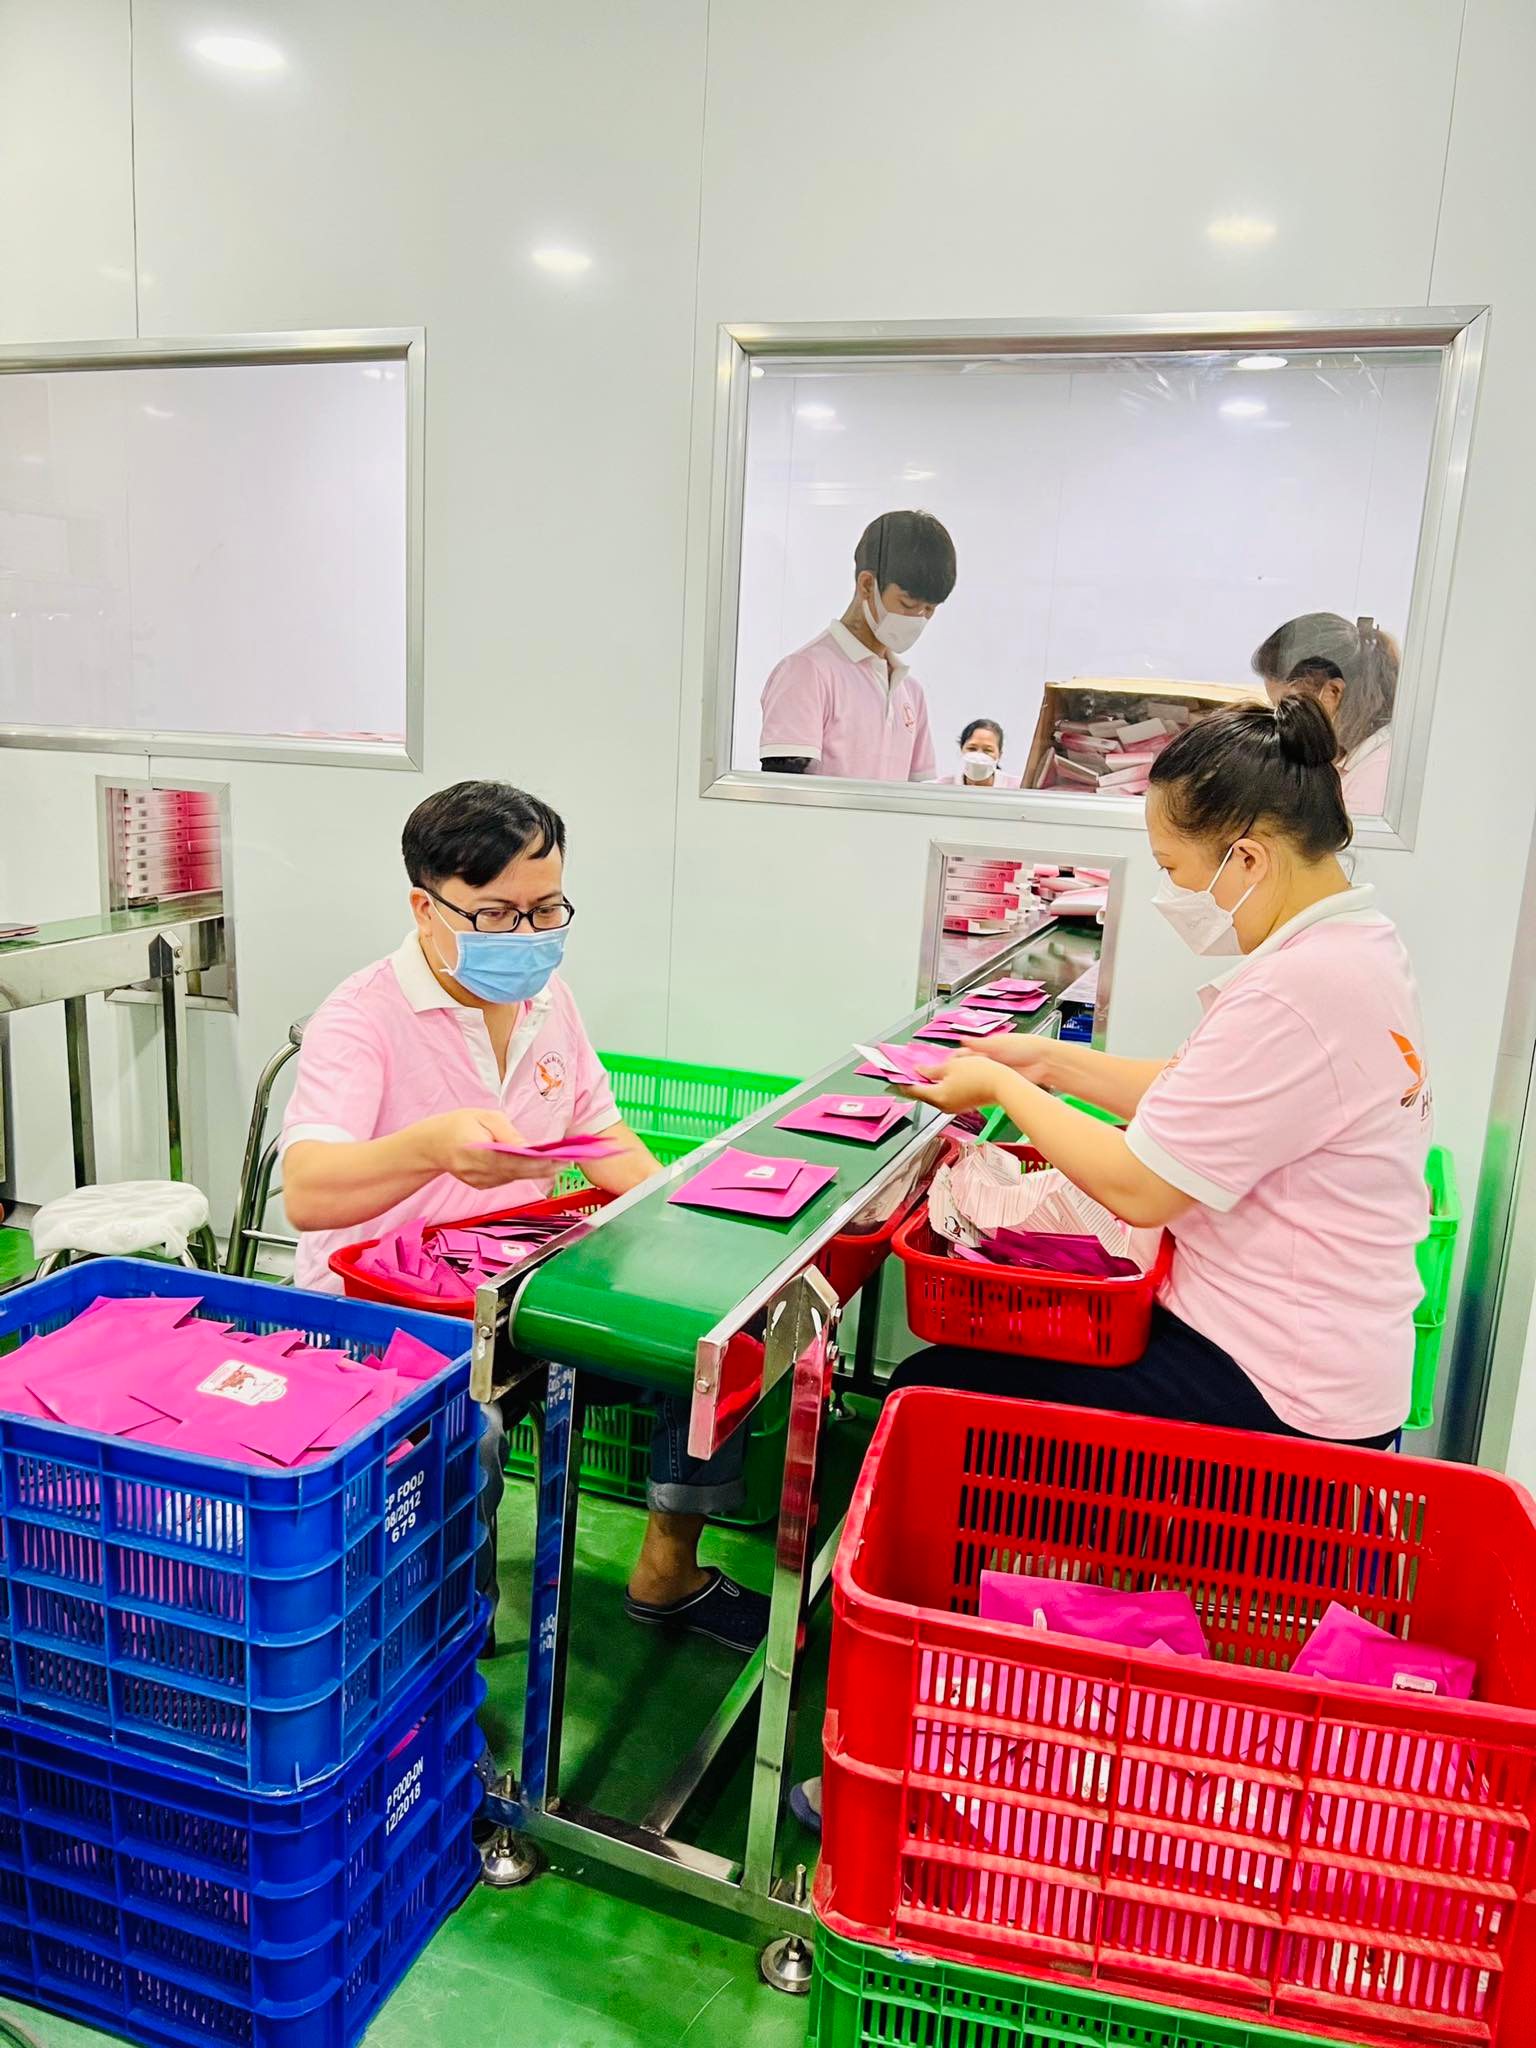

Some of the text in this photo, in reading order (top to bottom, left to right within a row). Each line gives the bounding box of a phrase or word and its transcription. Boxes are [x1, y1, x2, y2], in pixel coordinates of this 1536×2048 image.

[397, 1470, 425, 1502] FOOD
[385, 1491, 421, 1532] 08/2012
[391, 1512, 416, 1543] 679
[392, 1756, 424, 1807] FOOD-DN
[385, 1781, 421, 1837] 12/2018
